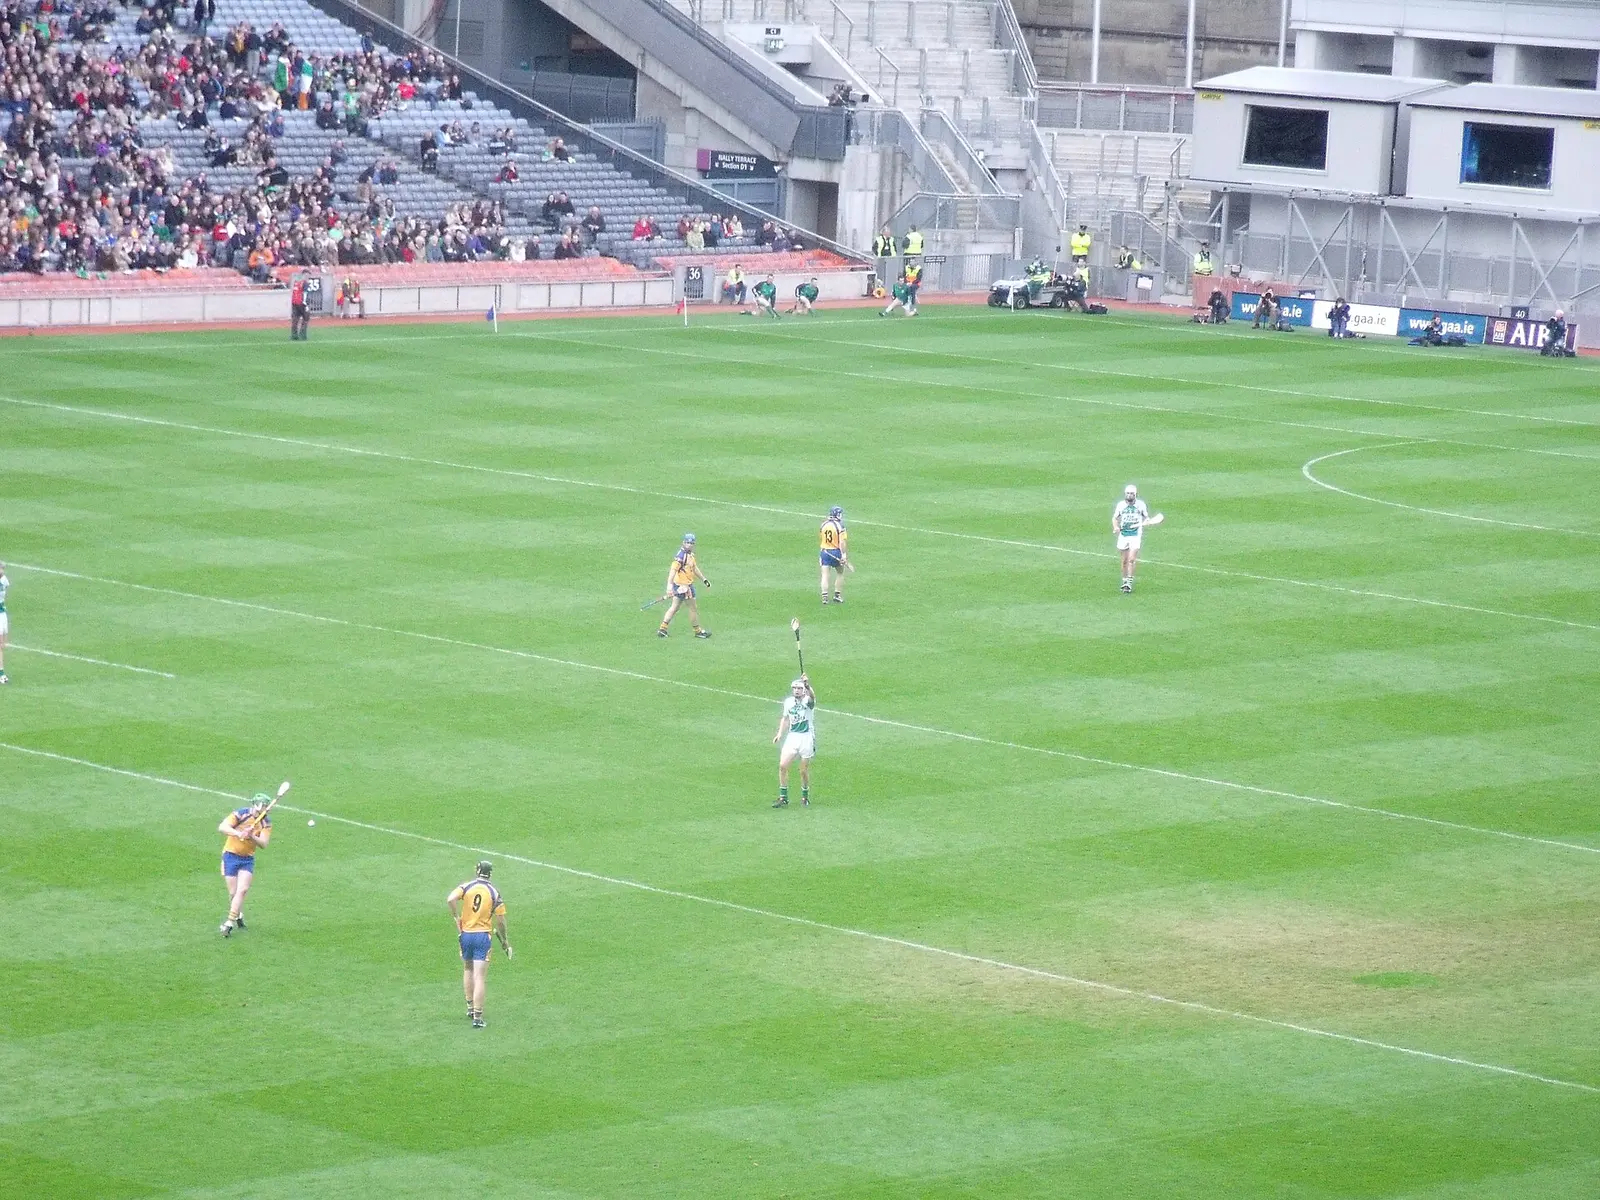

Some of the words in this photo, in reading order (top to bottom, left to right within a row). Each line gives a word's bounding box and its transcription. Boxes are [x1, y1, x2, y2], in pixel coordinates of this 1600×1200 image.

[722, 161, 740, 170] Section
[735, 155, 757, 165] TERRACE
[689, 267, 701, 280] 36
[307, 279, 320, 291] 35
[1515, 310, 1526, 319] 40
[824, 529, 833, 544] 13
[472, 893, 482, 913] 9
